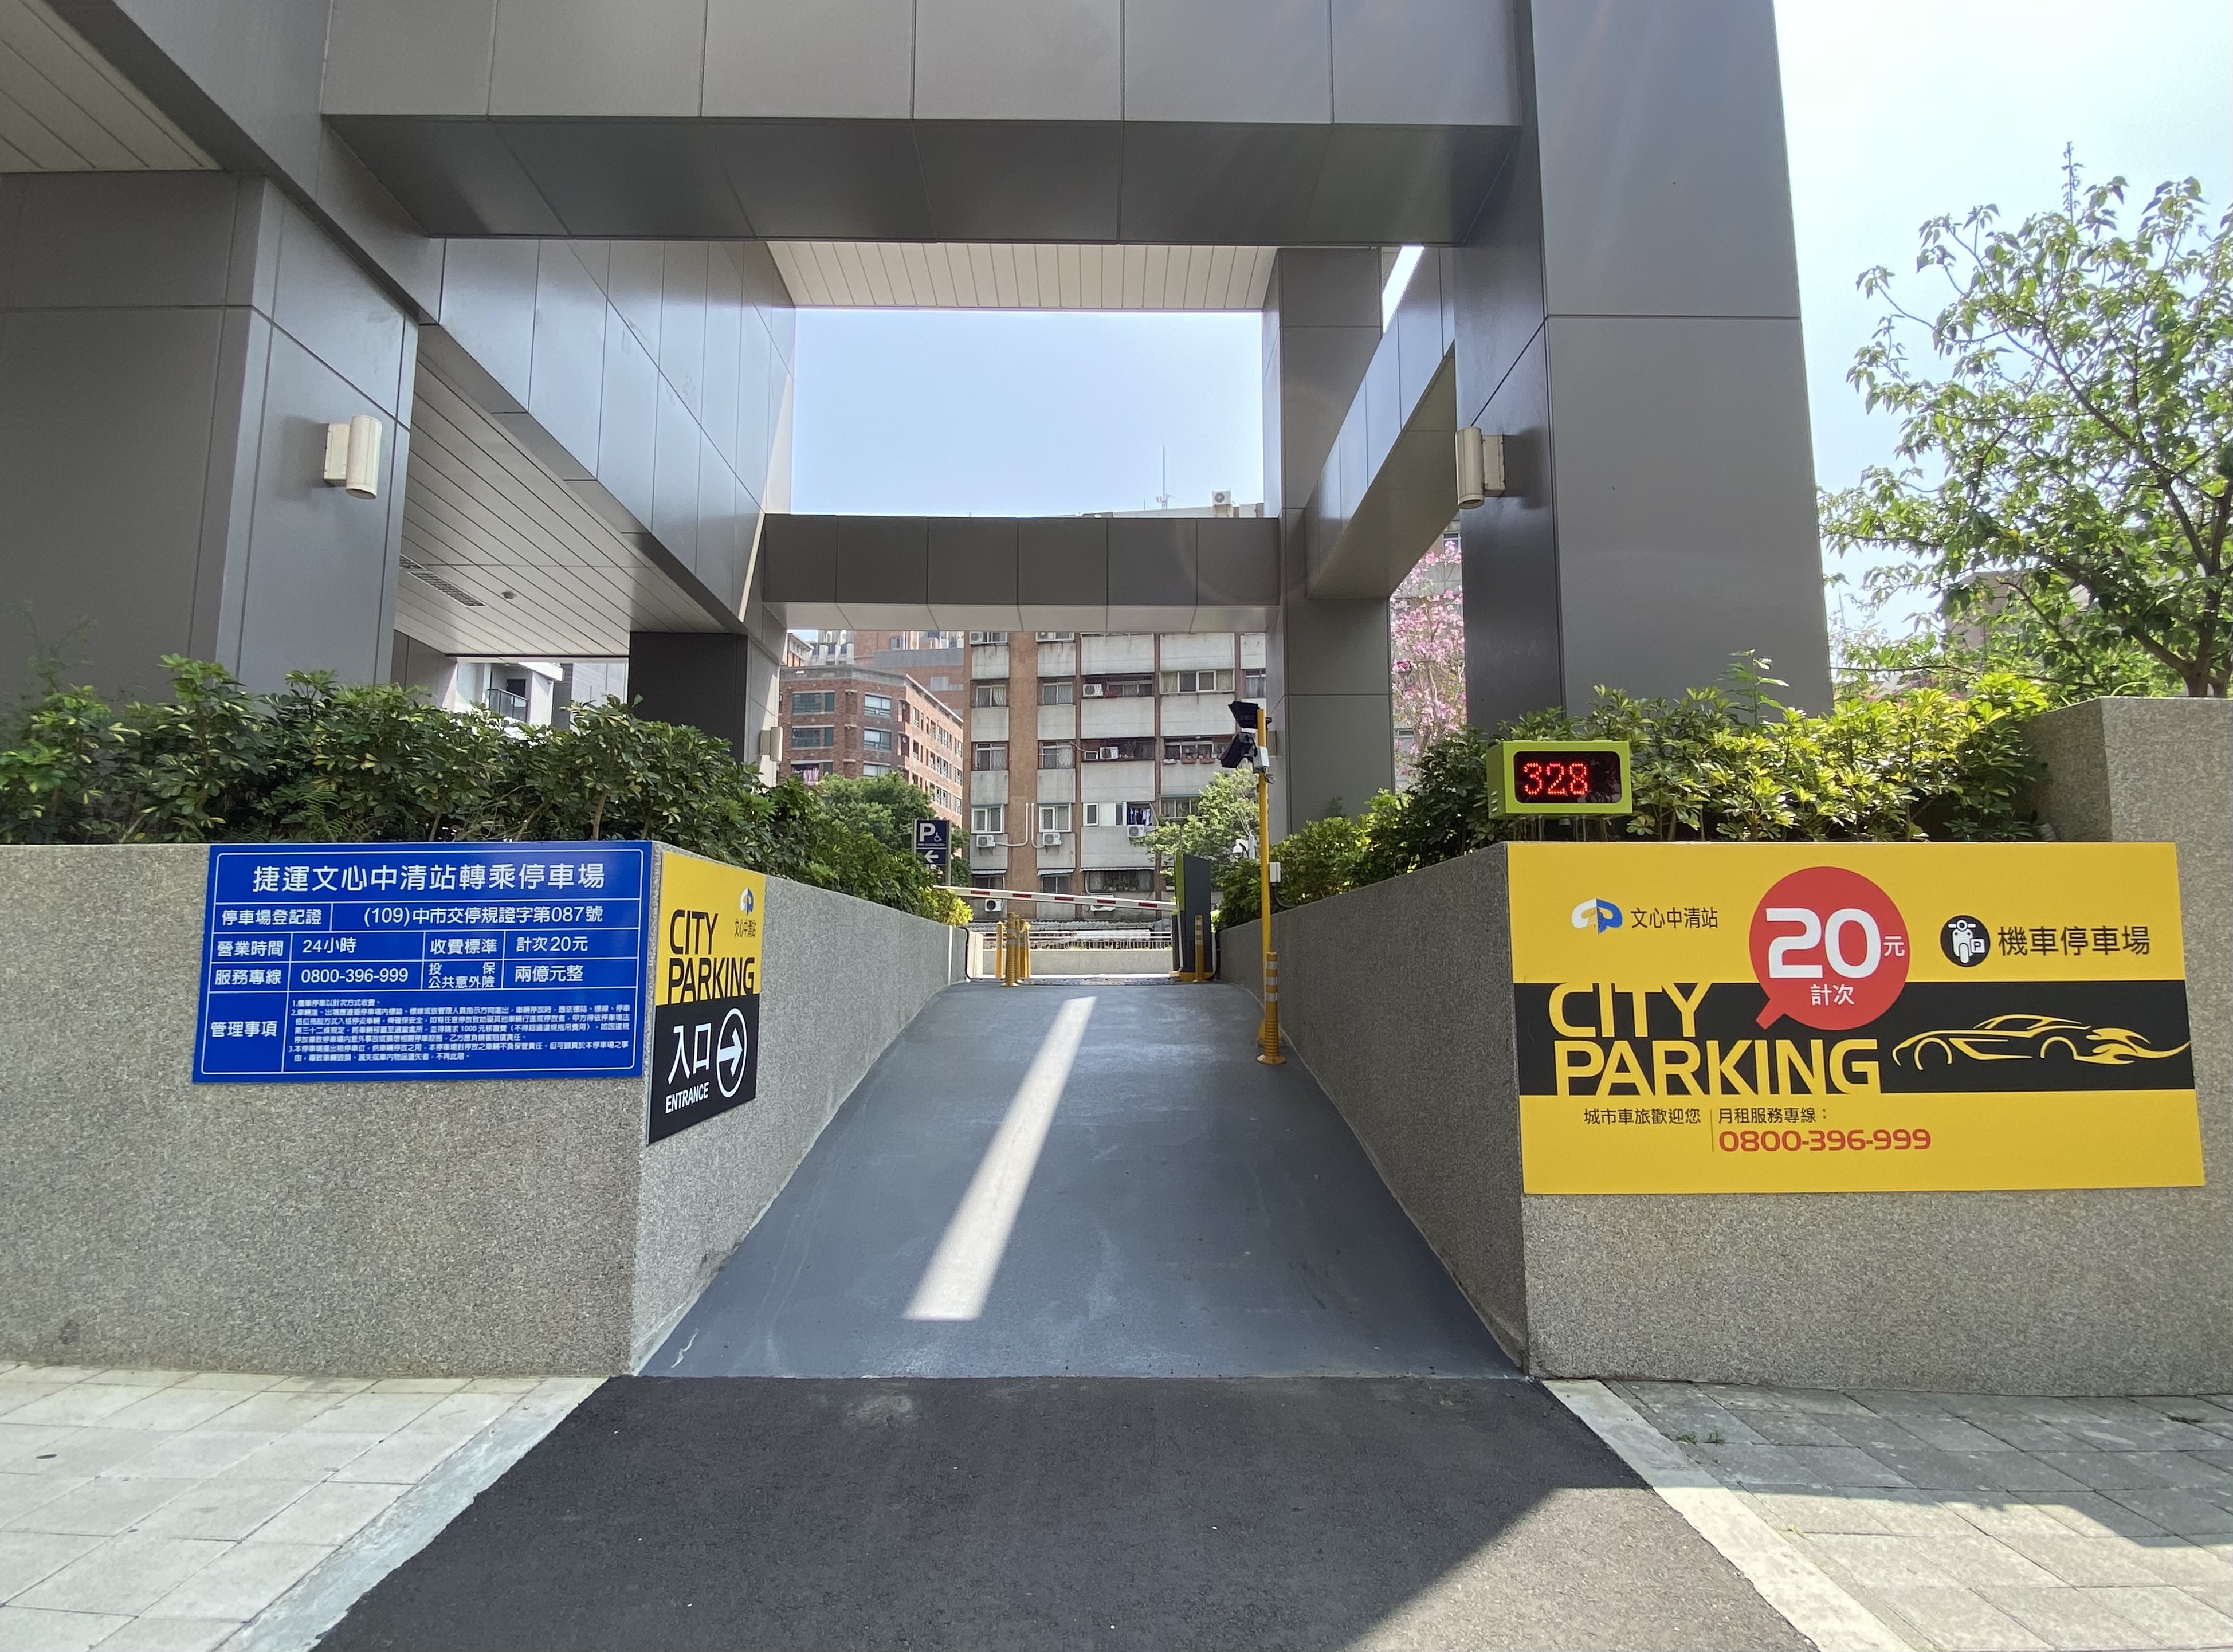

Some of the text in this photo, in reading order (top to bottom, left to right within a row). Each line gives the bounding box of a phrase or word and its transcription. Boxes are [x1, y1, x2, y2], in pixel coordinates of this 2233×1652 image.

[1523, 762, 1589, 796] 328
[920, 823, 936, 842] P
[253, 863, 605, 892] 捷運文心中清站轉乘停車場
[222, 909, 322, 926] 停車場登記證
[1630, 907, 1718, 929] 文心中清站
[670, 909, 718, 955] CITY
[1998, 925, 2150, 956] 機車停車場
[217, 940, 284, 957] 營業時間
[302, 937, 356, 953] 24小時
[430, 938, 497, 955] 收費標準
[214, 968, 282, 986] 服務專線
[301, 968, 409, 983] 0800-396-999
[428, 975, 495, 989] 公共意外險
[515, 965, 584, 983] 兩億元整
[668, 956, 755, 1005] PARKING
[1810, 983, 1855, 1006] 計次
[1548, 981, 1712, 1038] CITY
[210, 1021, 278, 1038] 管理事項
[668, 1023, 712, 1084] 入口
[1553, 1039, 1881, 1096] PARKING
[665, 1082, 709, 1114] ENTRANCE
[1584, 1108, 1701, 1124] 城市車旅歡迎您
[1719, 1129, 1931, 1152] 0800-396-999
